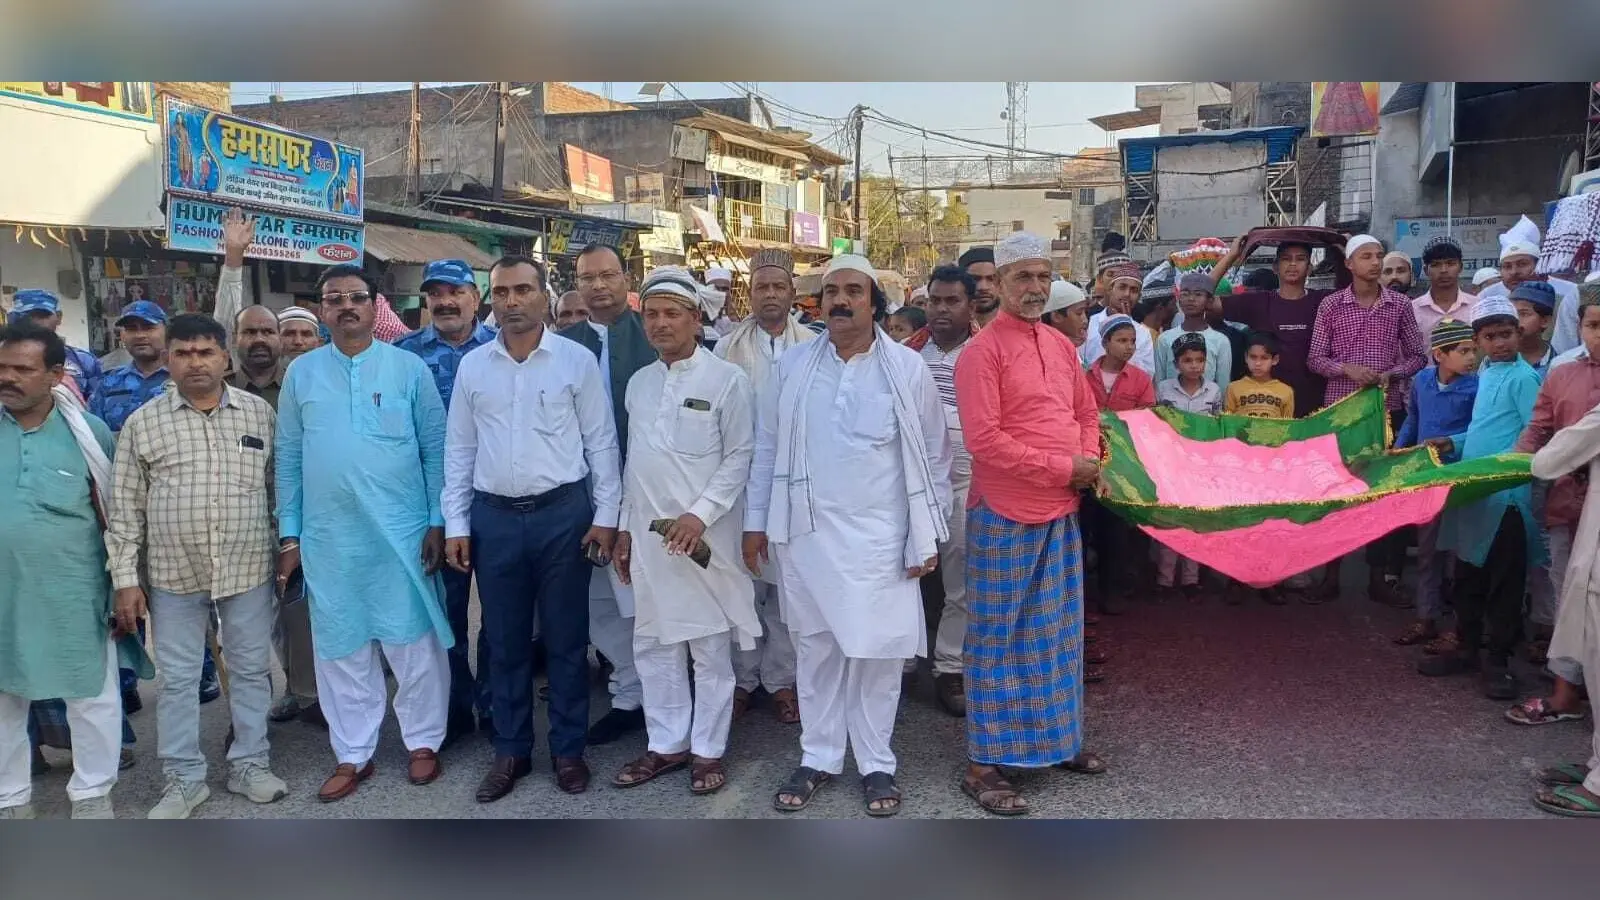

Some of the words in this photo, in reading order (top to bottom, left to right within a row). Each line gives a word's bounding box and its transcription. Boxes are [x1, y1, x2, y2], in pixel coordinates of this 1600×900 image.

[218, 119, 313, 174] हमसफर
[176, 202, 285, 233] HUMFAR
[291, 220, 361, 243] हमसफर
